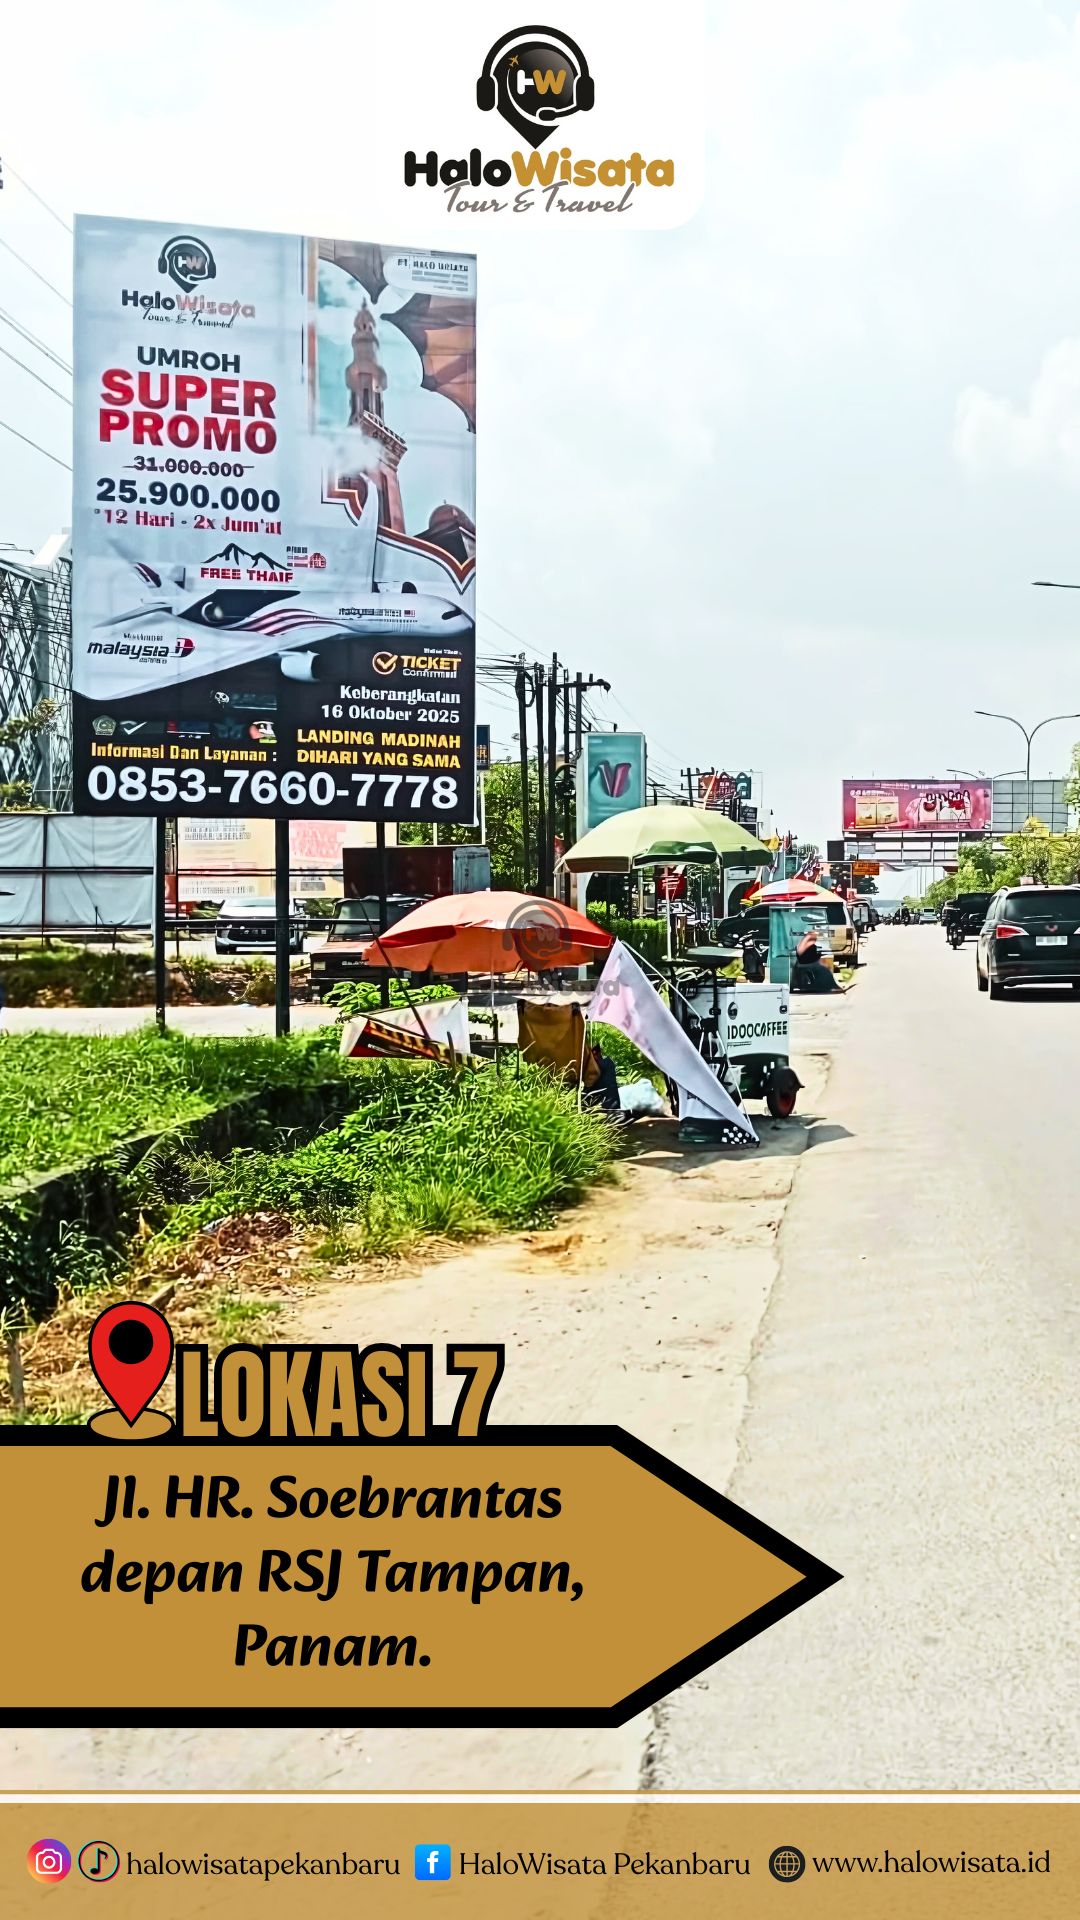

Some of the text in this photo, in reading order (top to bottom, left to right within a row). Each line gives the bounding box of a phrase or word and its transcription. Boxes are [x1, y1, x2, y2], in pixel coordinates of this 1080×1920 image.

[121, 289, 256, 319] HaloWisata
[136, 345, 241, 374] UMROH
[100, 368, 277, 419] SUPER
[98, 407, 277, 455] PROMO
[132, 455, 245, 478] 31.000.000
[95, 477, 281, 513] 25.900.000
[104, 508, 128, 524] 12
[135, 510, 175, 527] Hari
[193, 514, 216, 530] 2x
[221, 516, 282, 535] Jum'at
[200, 567, 294, 583] FREE THAIF
[87, 641, 170, 660] malaysia
[400, 655, 462, 671] TICKET
[340, 685, 461, 705] Keberangkatan
[321, 704, 460, 724] 16 Oktober 2025
[297, 729, 461, 749] LANDING MADINAH
[91, 742, 164, 759] Informasi
[169, 745, 199, 760] Dan
[204, 746, 267, 763] Layanan
[297, 750, 358, 765] DIHARI
[362, 751, 409, 767] YANG
[412, 753, 461, 769] SAMA
[87, 765, 459, 810] 0853-7660-7778
